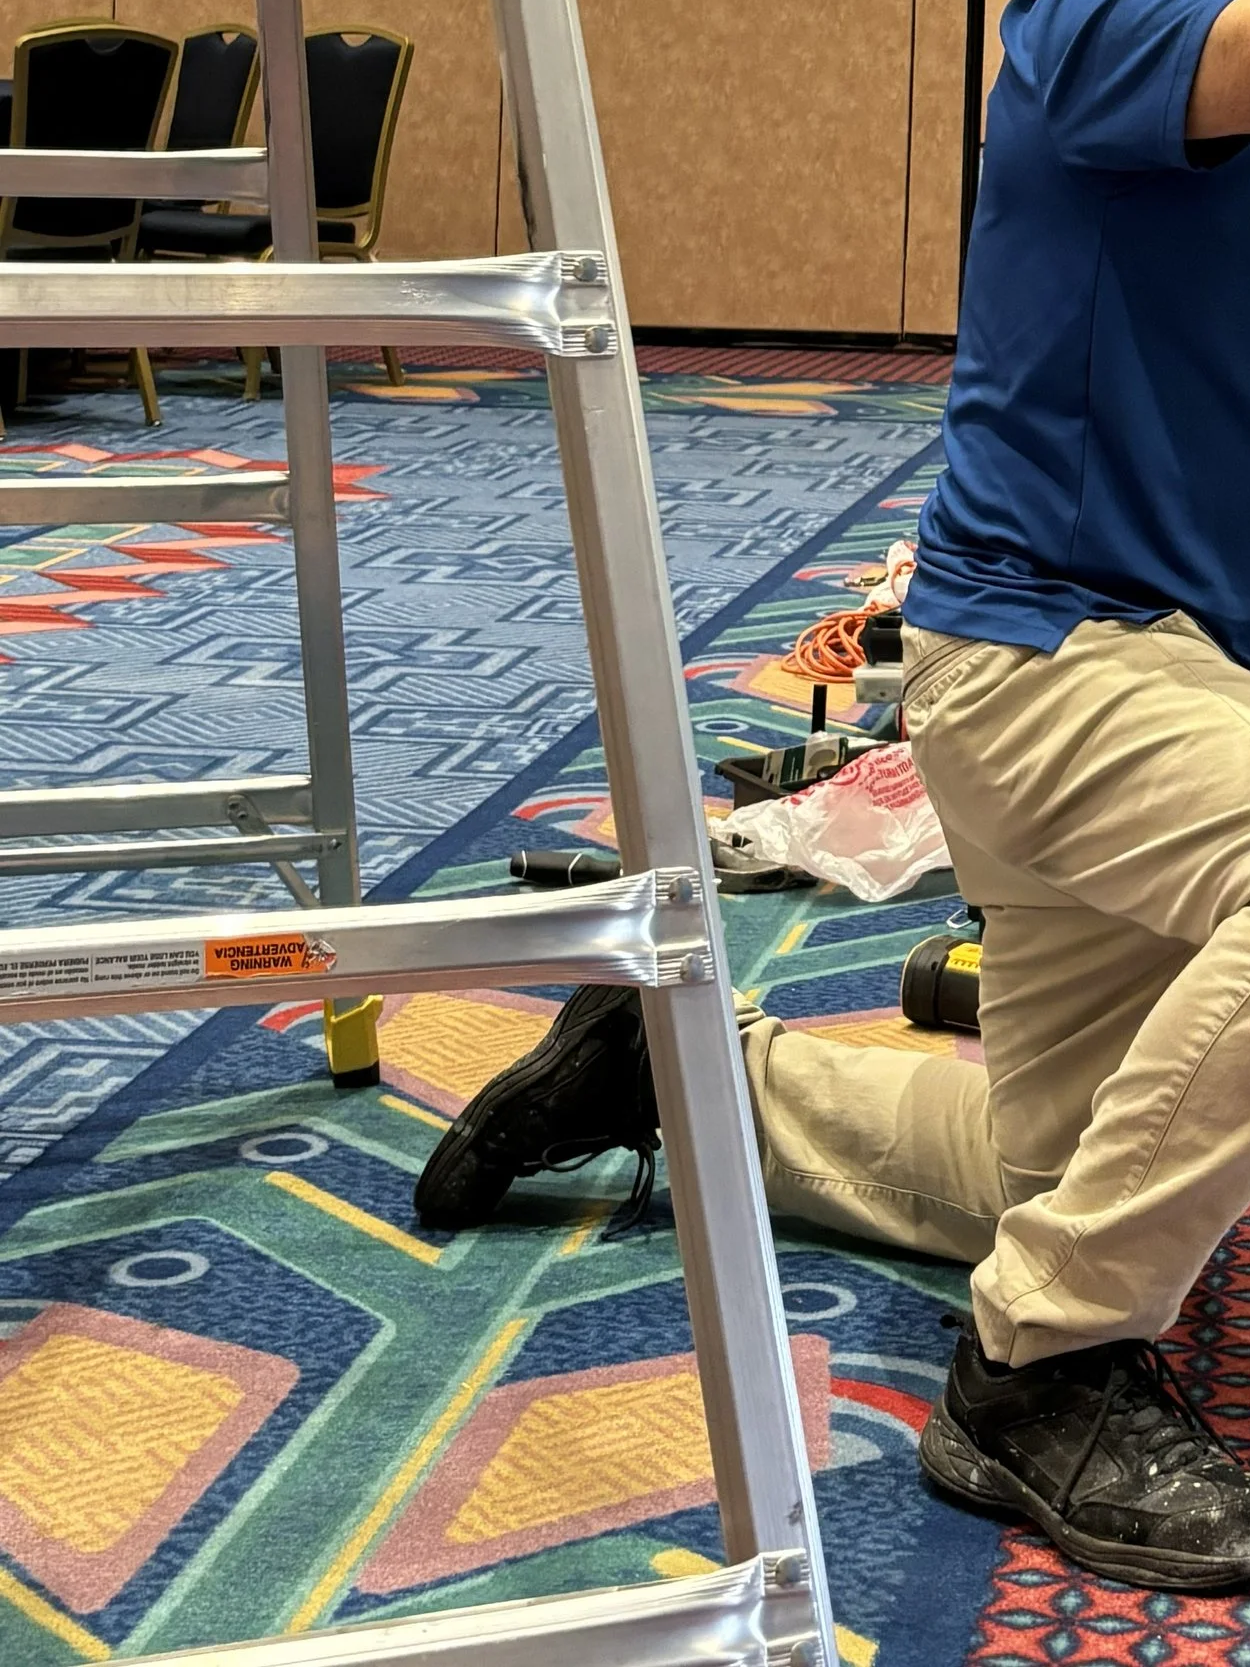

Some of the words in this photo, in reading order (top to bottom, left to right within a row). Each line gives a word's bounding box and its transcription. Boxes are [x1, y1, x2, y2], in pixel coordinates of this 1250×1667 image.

[214, 942, 306, 959] ADVERTENCIA
[95, 955, 128, 965] BALANCE
[230, 955, 292, 971] WARNING
